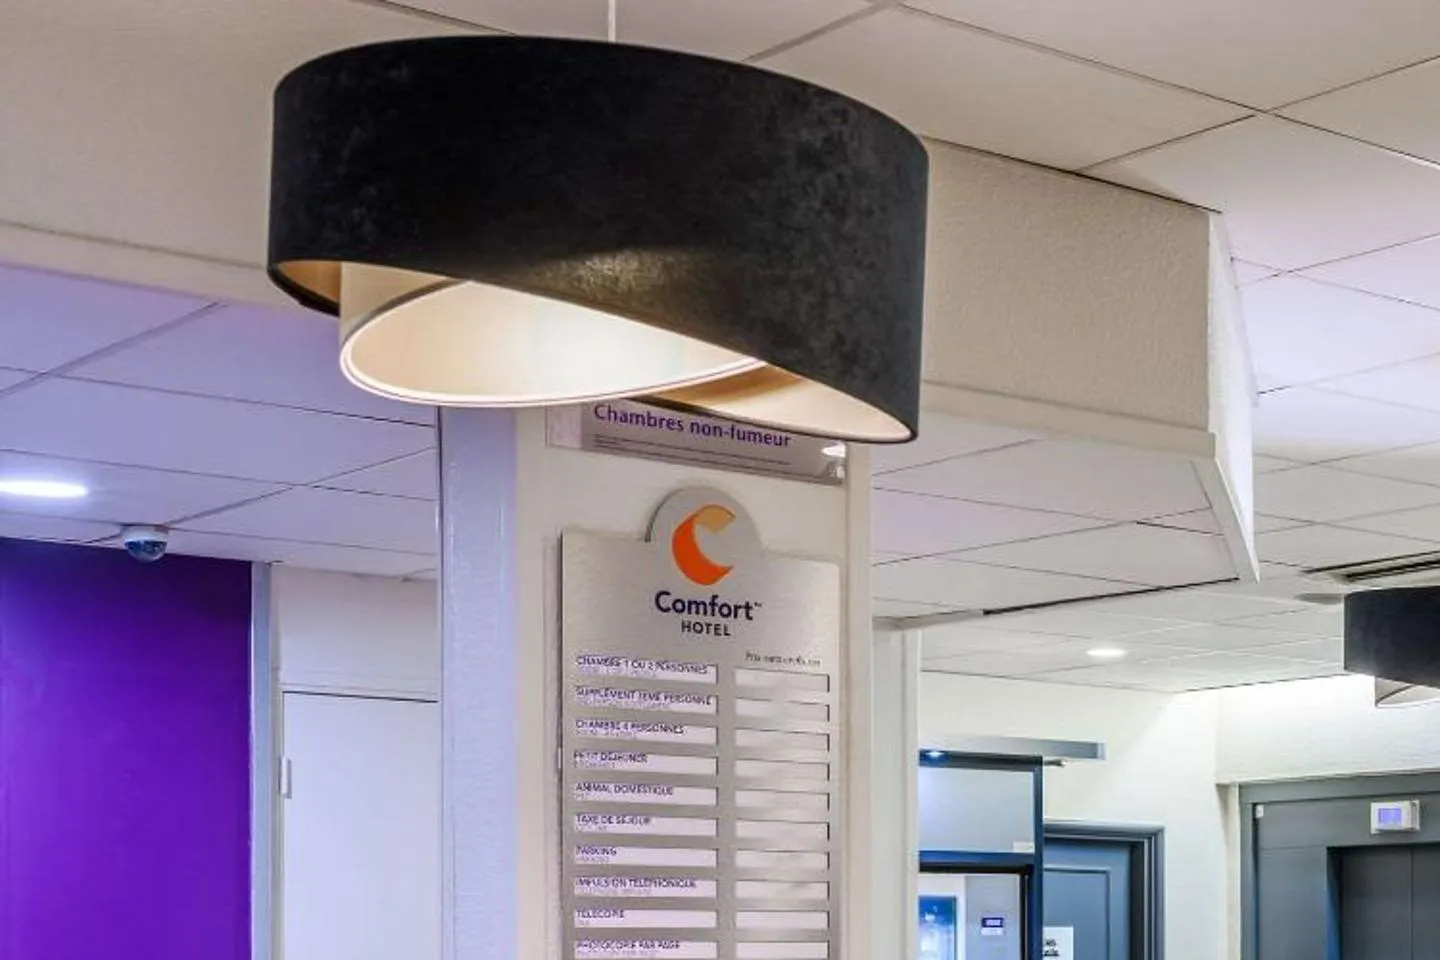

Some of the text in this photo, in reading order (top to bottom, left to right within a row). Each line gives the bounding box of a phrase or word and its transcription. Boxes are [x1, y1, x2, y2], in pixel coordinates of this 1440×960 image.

[594, 403, 684, 432] Chambres
[690, 420, 791, 447] non-fumeur
[654, 590, 754, 620] Comfort
[681, 620, 731, 636] HOTEL
